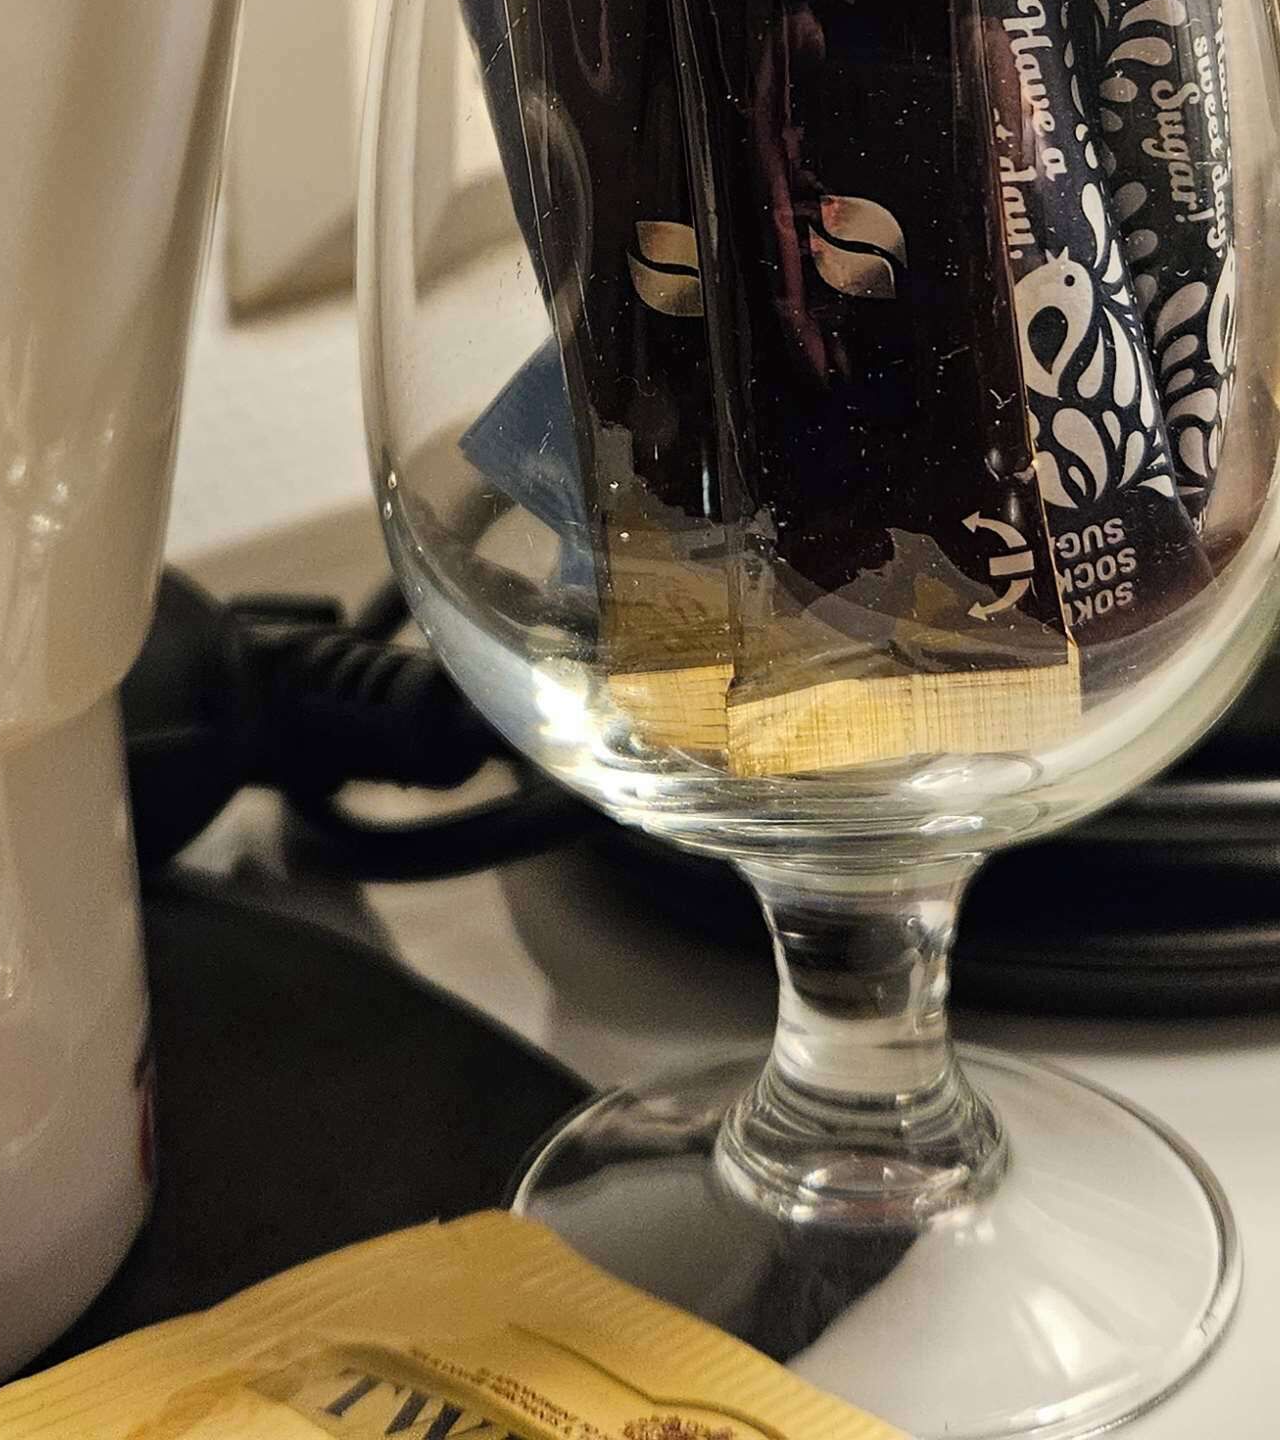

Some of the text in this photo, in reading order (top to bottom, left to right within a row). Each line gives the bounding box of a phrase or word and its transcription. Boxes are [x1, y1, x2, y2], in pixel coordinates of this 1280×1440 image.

[1193, 35, 1223, 158] sweet
[1040, 146, 1069, 182] a
[1141, 79, 1215, 224] Sugar!
[1048, 516, 1125, 559] SUG
